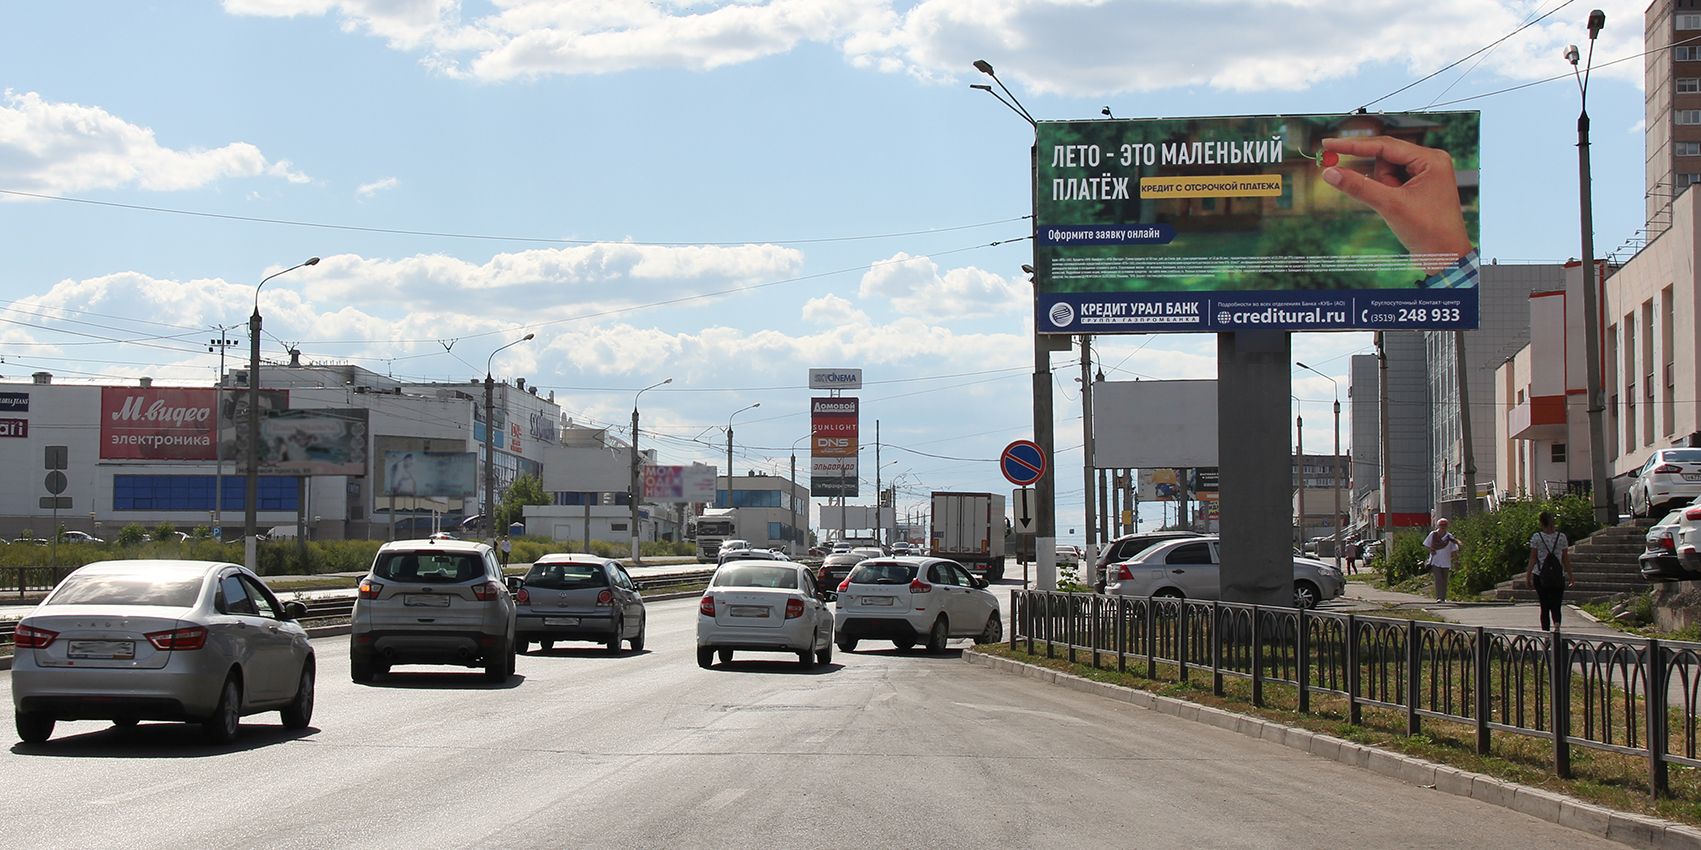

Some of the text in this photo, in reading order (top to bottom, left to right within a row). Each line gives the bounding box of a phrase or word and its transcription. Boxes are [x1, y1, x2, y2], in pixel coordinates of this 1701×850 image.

[1052, 145, 1100, 168] ЛЕТО
[1120, 143, 1155, 166] ЭТО
[1161, 135, 1283, 165] МАЛЕНЬКИЙ
[1053, 173, 1130, 201] ПЛАТЁЖ
[1141, 184, 1174, 193] КРЕДИТ
[1184, 181, 1238, 192] ОТСРОЧКОЙ
[1239, 181, 1281, 191] ПЛАТЕЖА
[1048, 229, 1160, 242] Оформите заявку онлайн
[1081, 302, 1199, 317] КРЕДИТ УРАЛ БАНК
[1233, 308, 1345, 324] creditural.ru
[1370, 308, 1460, 323] (3519) 248 933
[112, 396, 210, 426] М.видео
[111, 434, 210, 448] электроника
[817, 438, 849, 447] DNS
